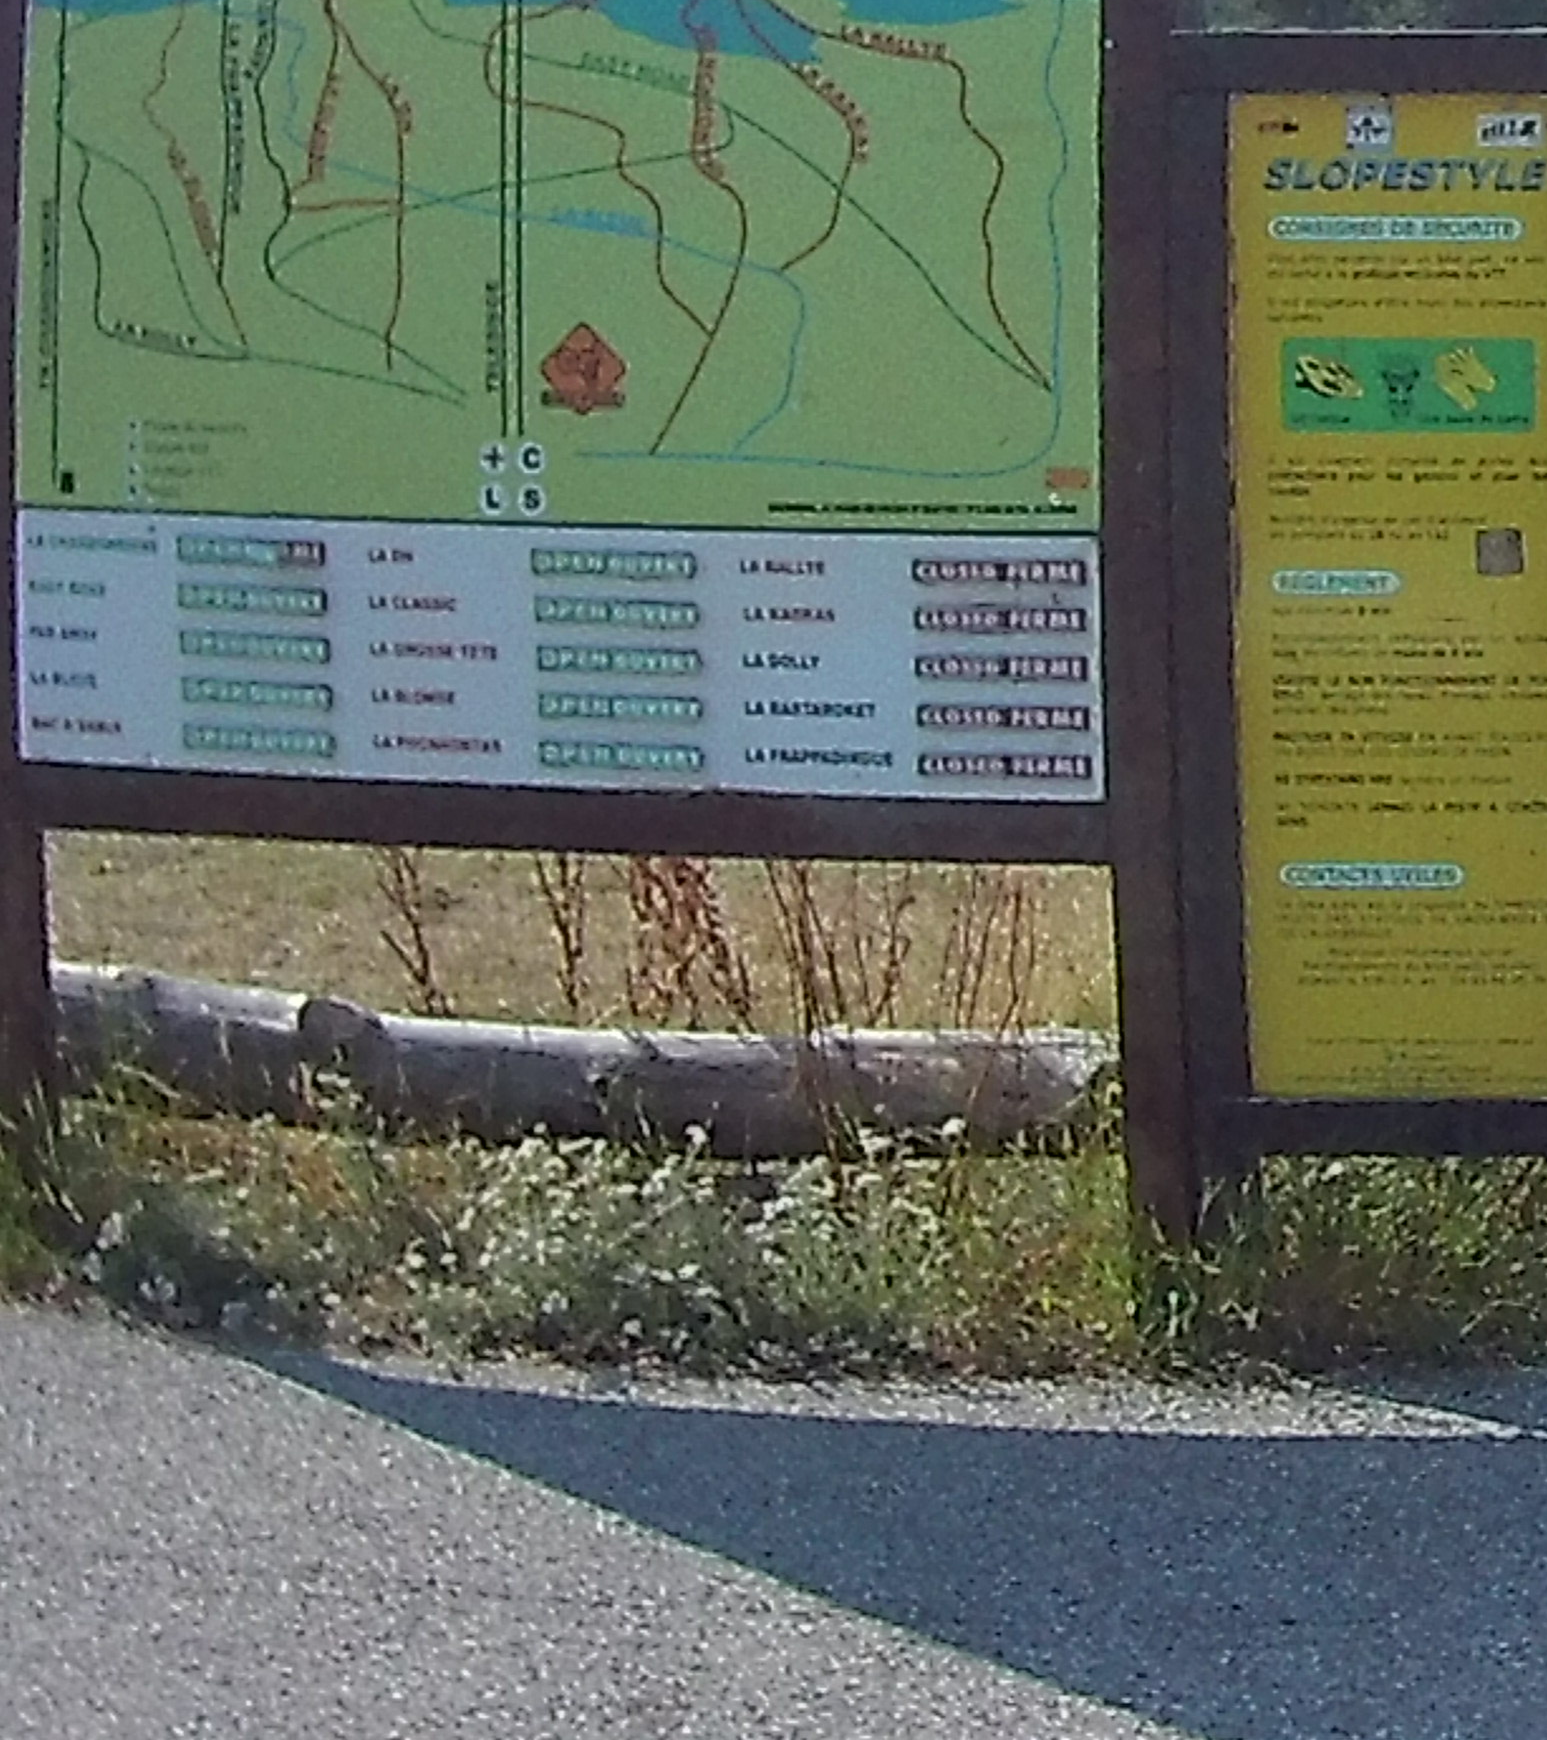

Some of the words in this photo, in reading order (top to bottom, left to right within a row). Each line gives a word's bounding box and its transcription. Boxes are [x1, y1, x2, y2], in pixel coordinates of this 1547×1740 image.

[1263, 159, 1546, 192] SLOPESTYLE
[740, 561, 760, 575] LA
[743, 608, 764, 621] LA
[743, 654, 764, 668] LA
[745, 701, 764, 715] LA
[745, 748, 764, 762] LA
